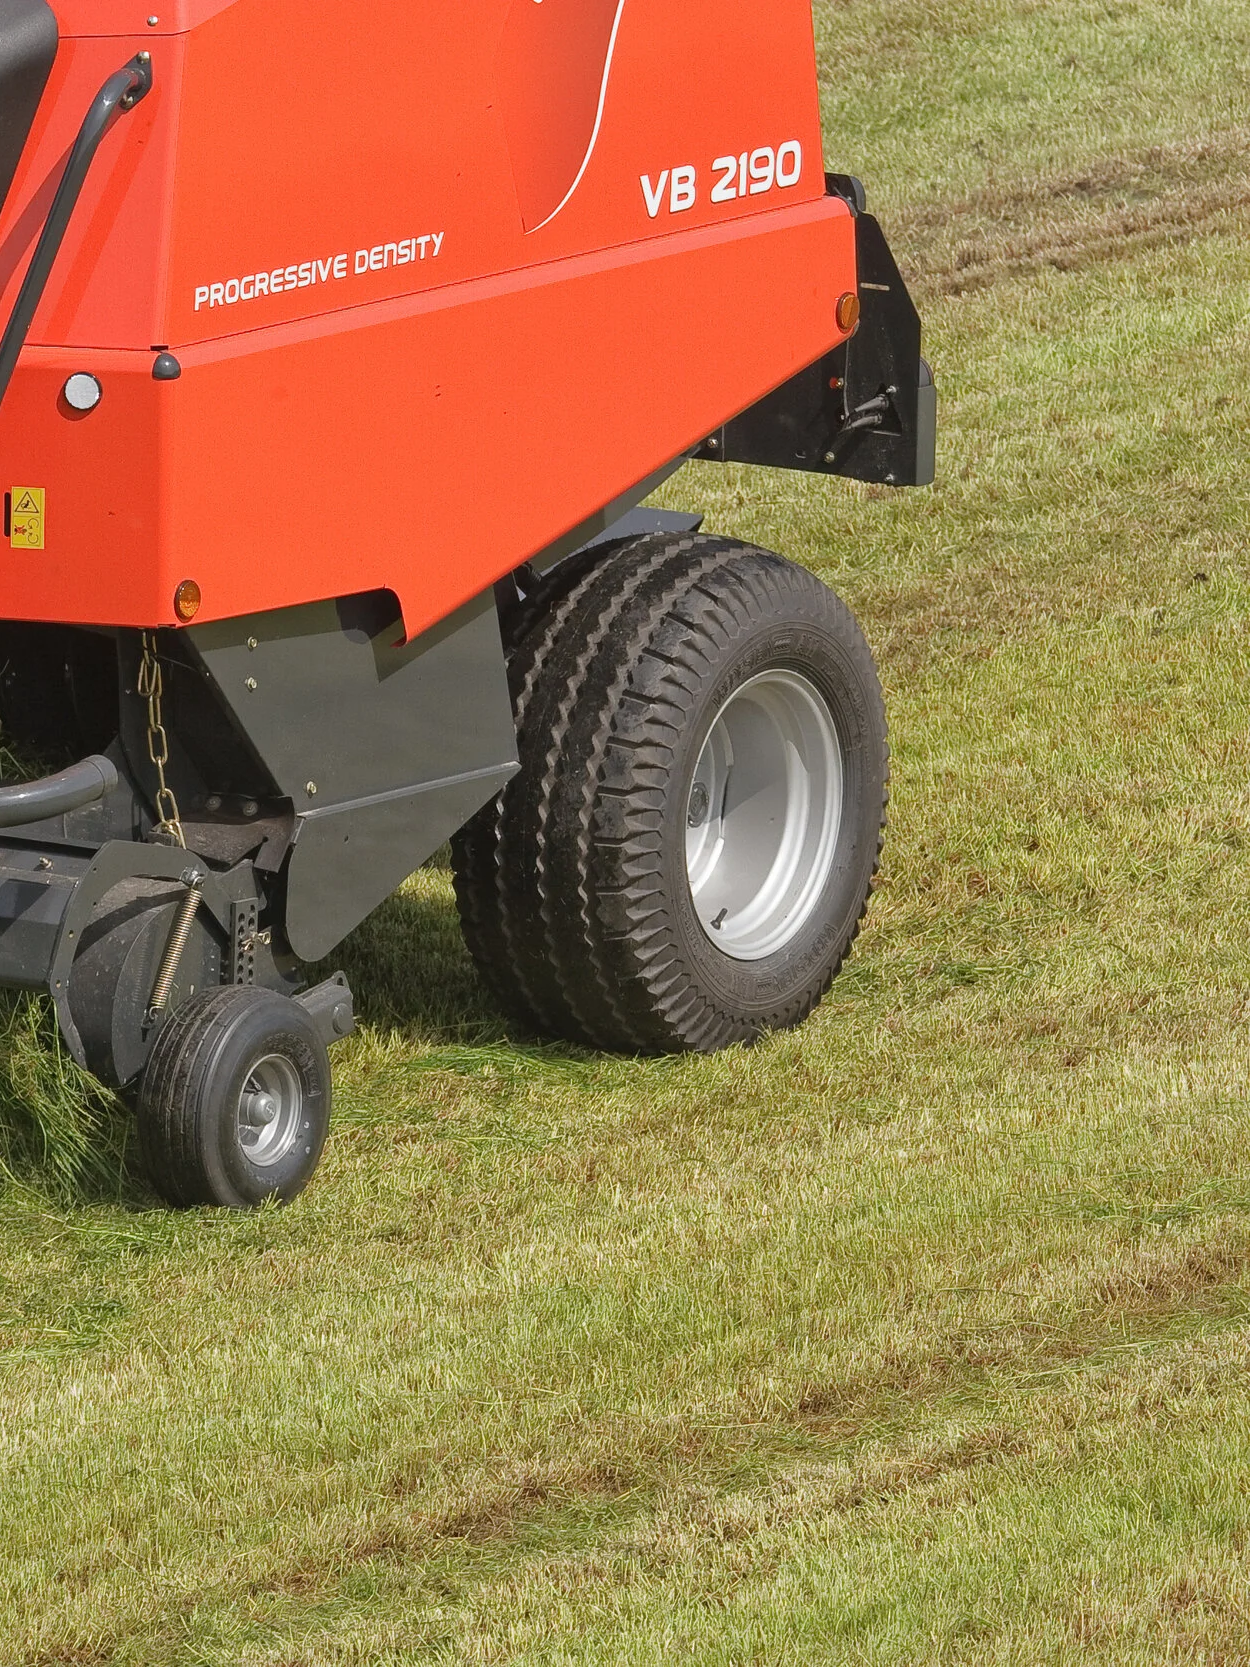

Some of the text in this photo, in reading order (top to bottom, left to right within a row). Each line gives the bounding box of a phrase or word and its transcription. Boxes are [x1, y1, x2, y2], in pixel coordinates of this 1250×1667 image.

[640, 140, 802, 219] VB 2190
[193, 231, 445, 311] PROGRESSIVE DENSITY
